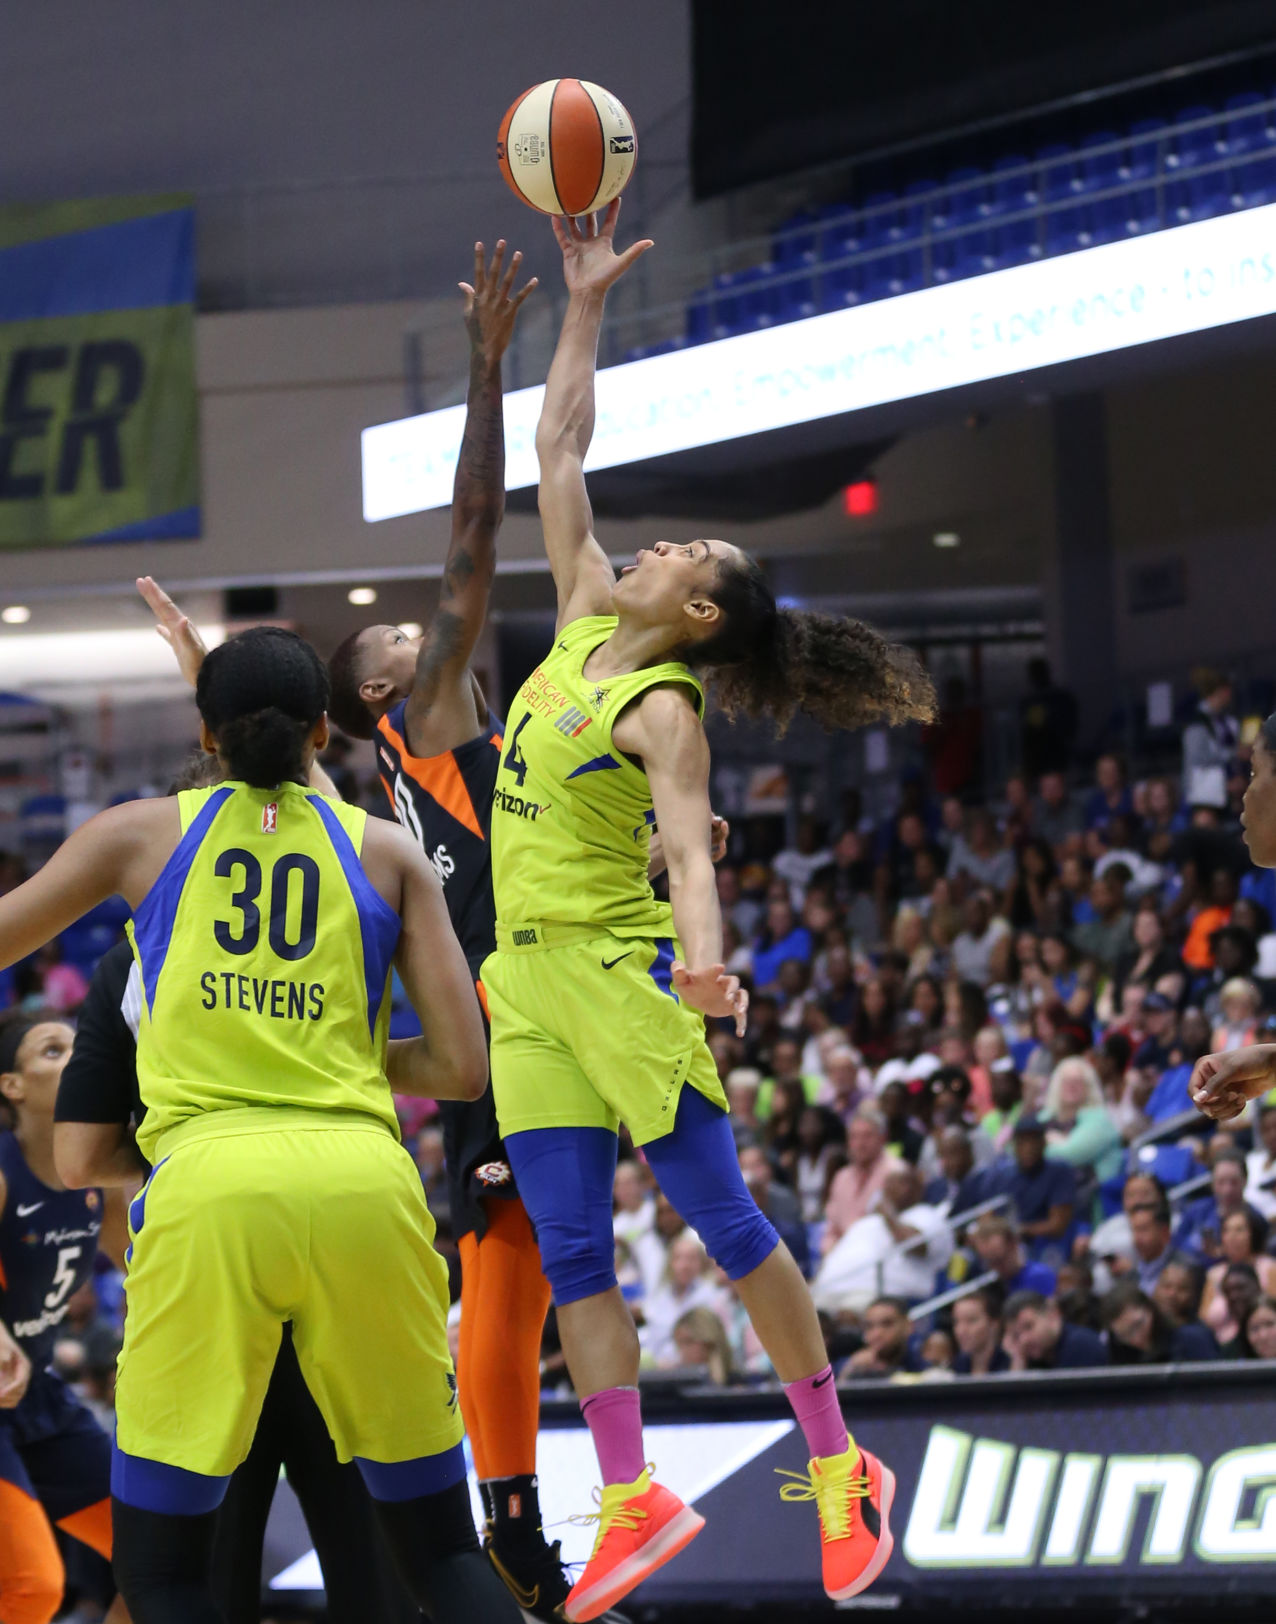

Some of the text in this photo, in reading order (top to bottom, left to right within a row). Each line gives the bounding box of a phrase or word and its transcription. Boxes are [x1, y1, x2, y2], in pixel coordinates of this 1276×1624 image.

[504, 711, 533, 787] 4
[213, 847, 321, 962] 30
[200, 971, 326, 1022] STEVENS
[44, 1246, 81, 1308] 5
